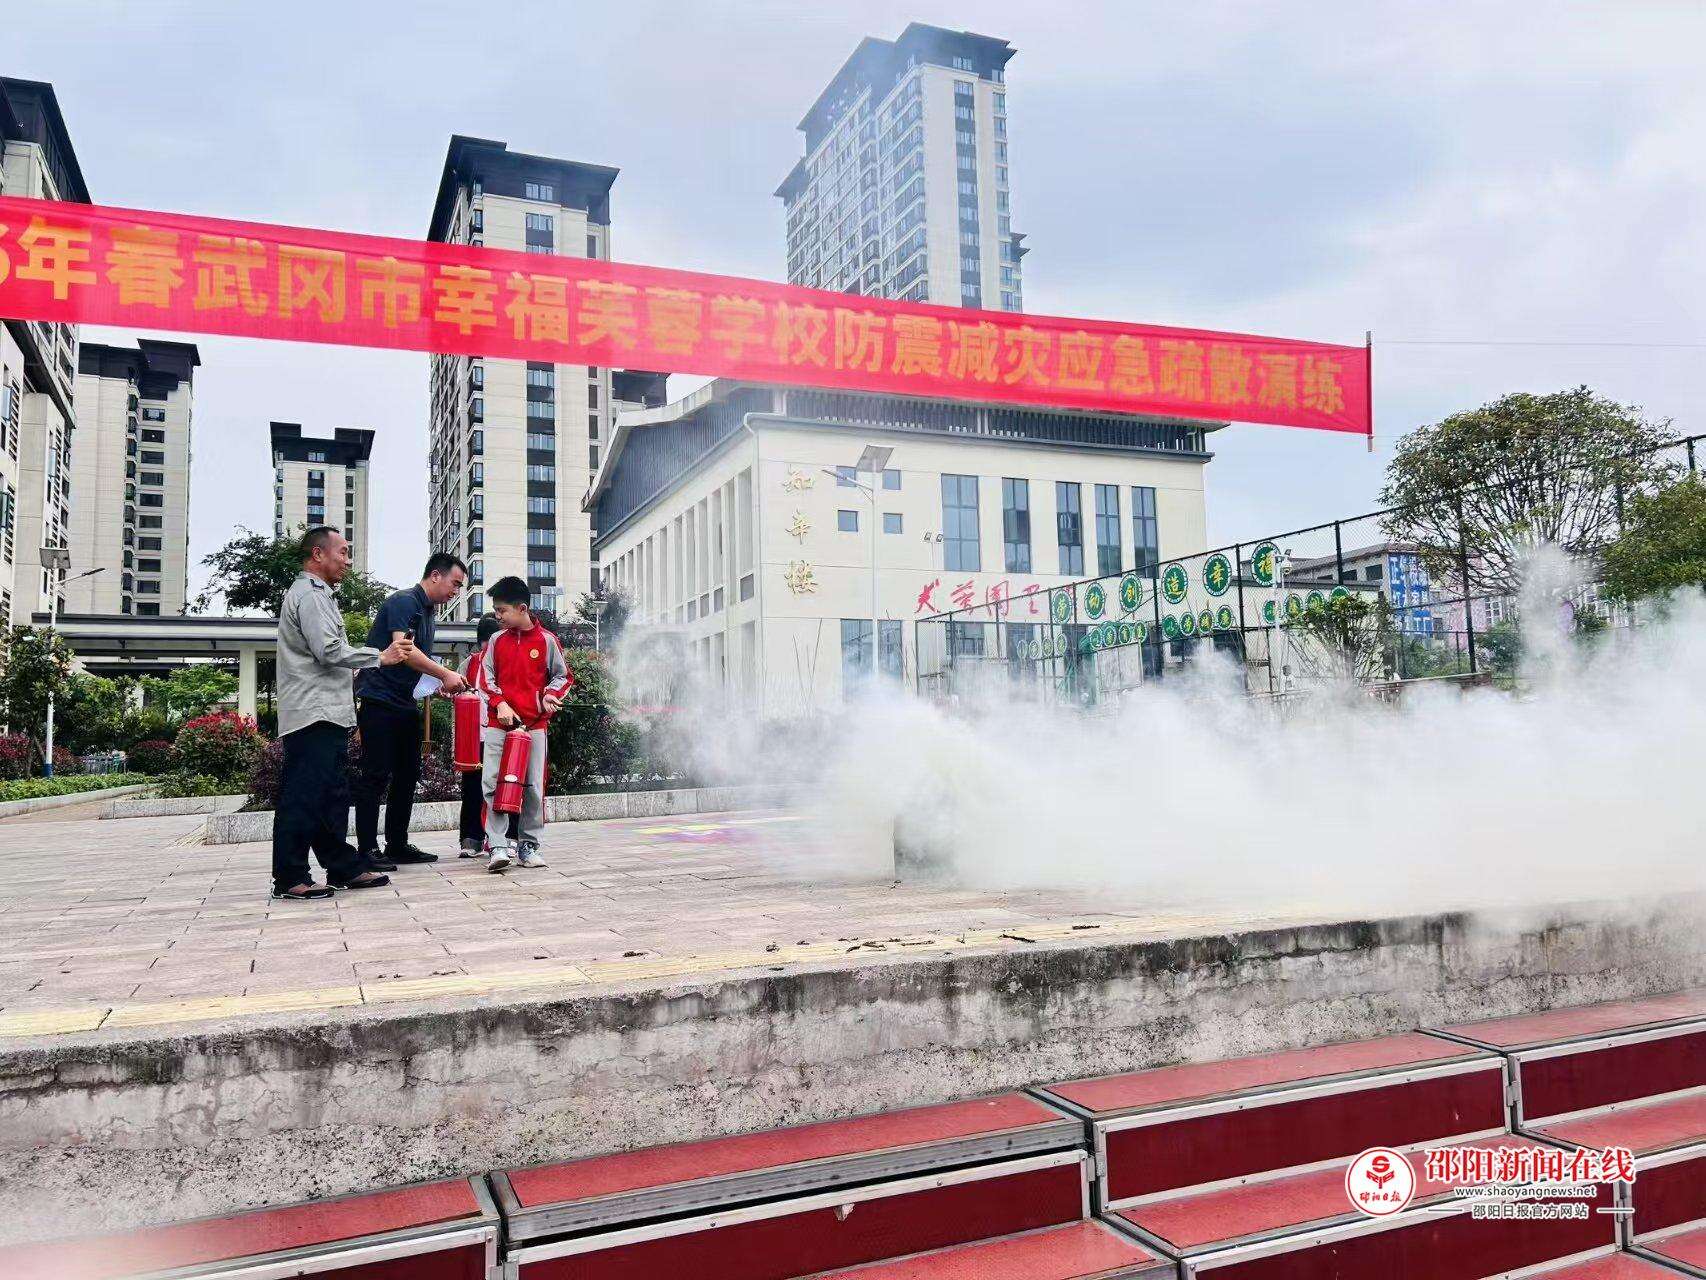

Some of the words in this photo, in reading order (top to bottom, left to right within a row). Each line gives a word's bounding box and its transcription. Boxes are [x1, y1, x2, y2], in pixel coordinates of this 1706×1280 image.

[0, 214, 1344, 414] 年春武冈市幸福芙蓉学校防震减灾应急疏散演练
